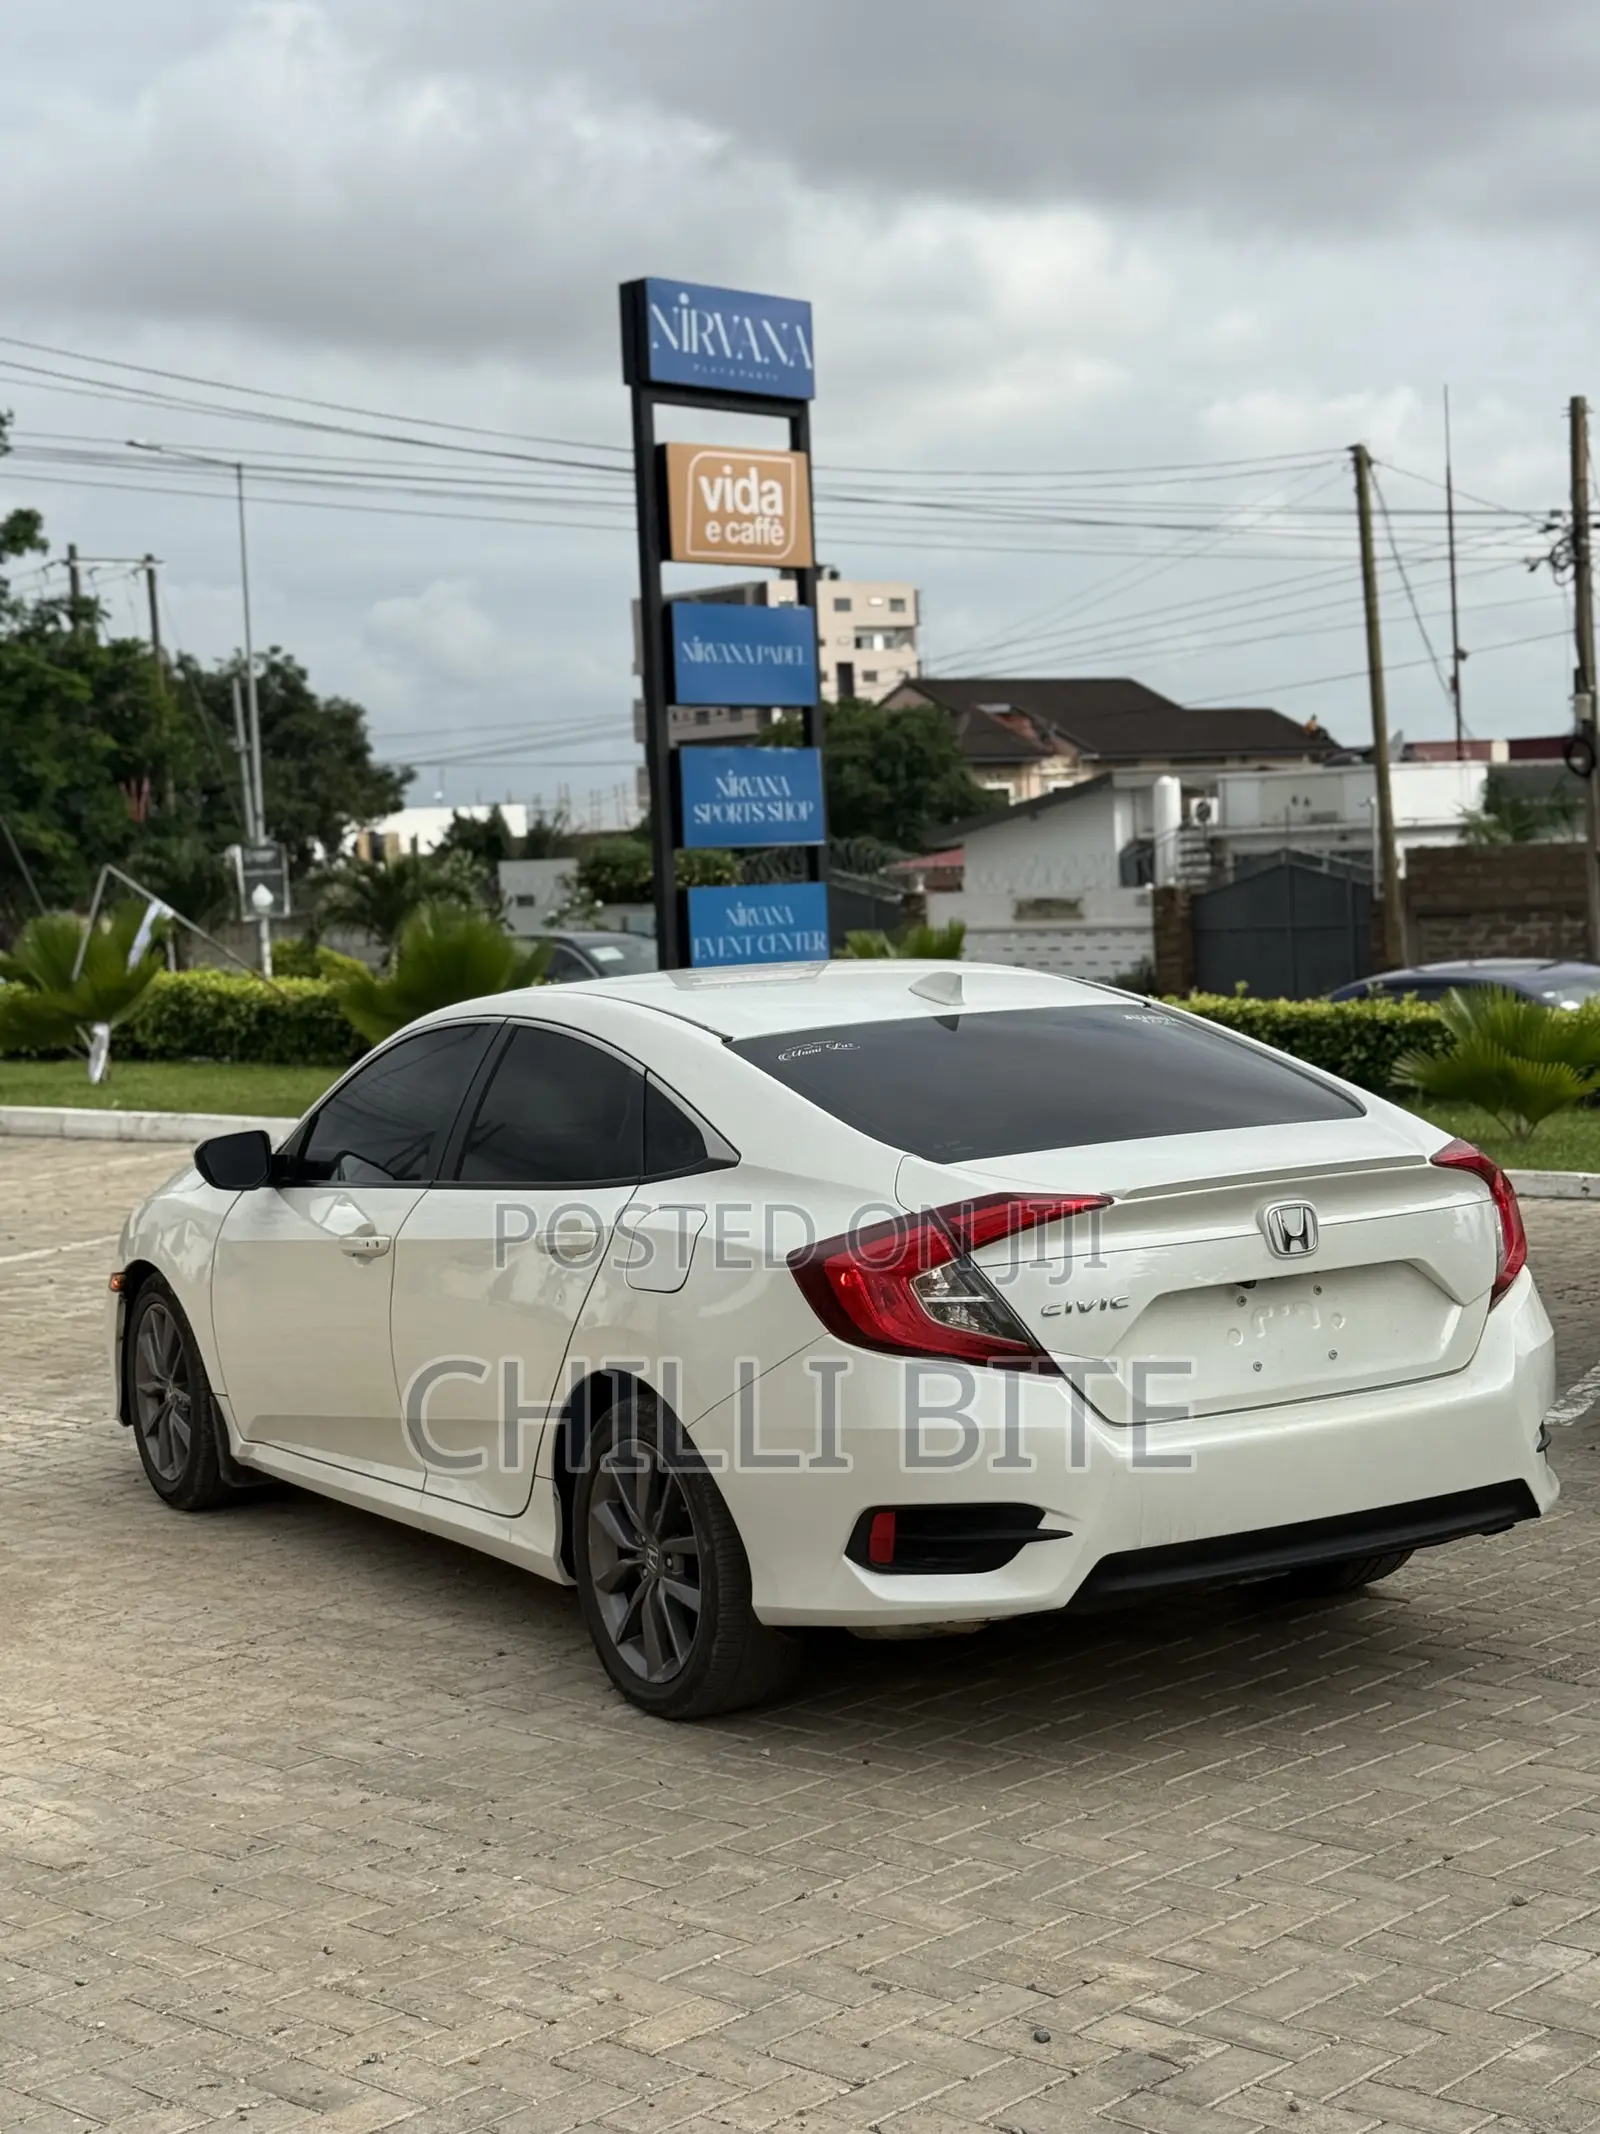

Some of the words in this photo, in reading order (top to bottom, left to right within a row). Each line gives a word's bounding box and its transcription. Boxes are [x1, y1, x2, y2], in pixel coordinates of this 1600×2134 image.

[699, 464, 785, 517] vida
[705, 519, 722, 544] e
[692, 801, 766, 824] SPORTS
[766, 800, 815, 822] SHOP
[693, 934, 756, 960] EVENT
[757, 930, 827, 954] CENTER
[1040, 1295, 1130, 1318] CIVIC
